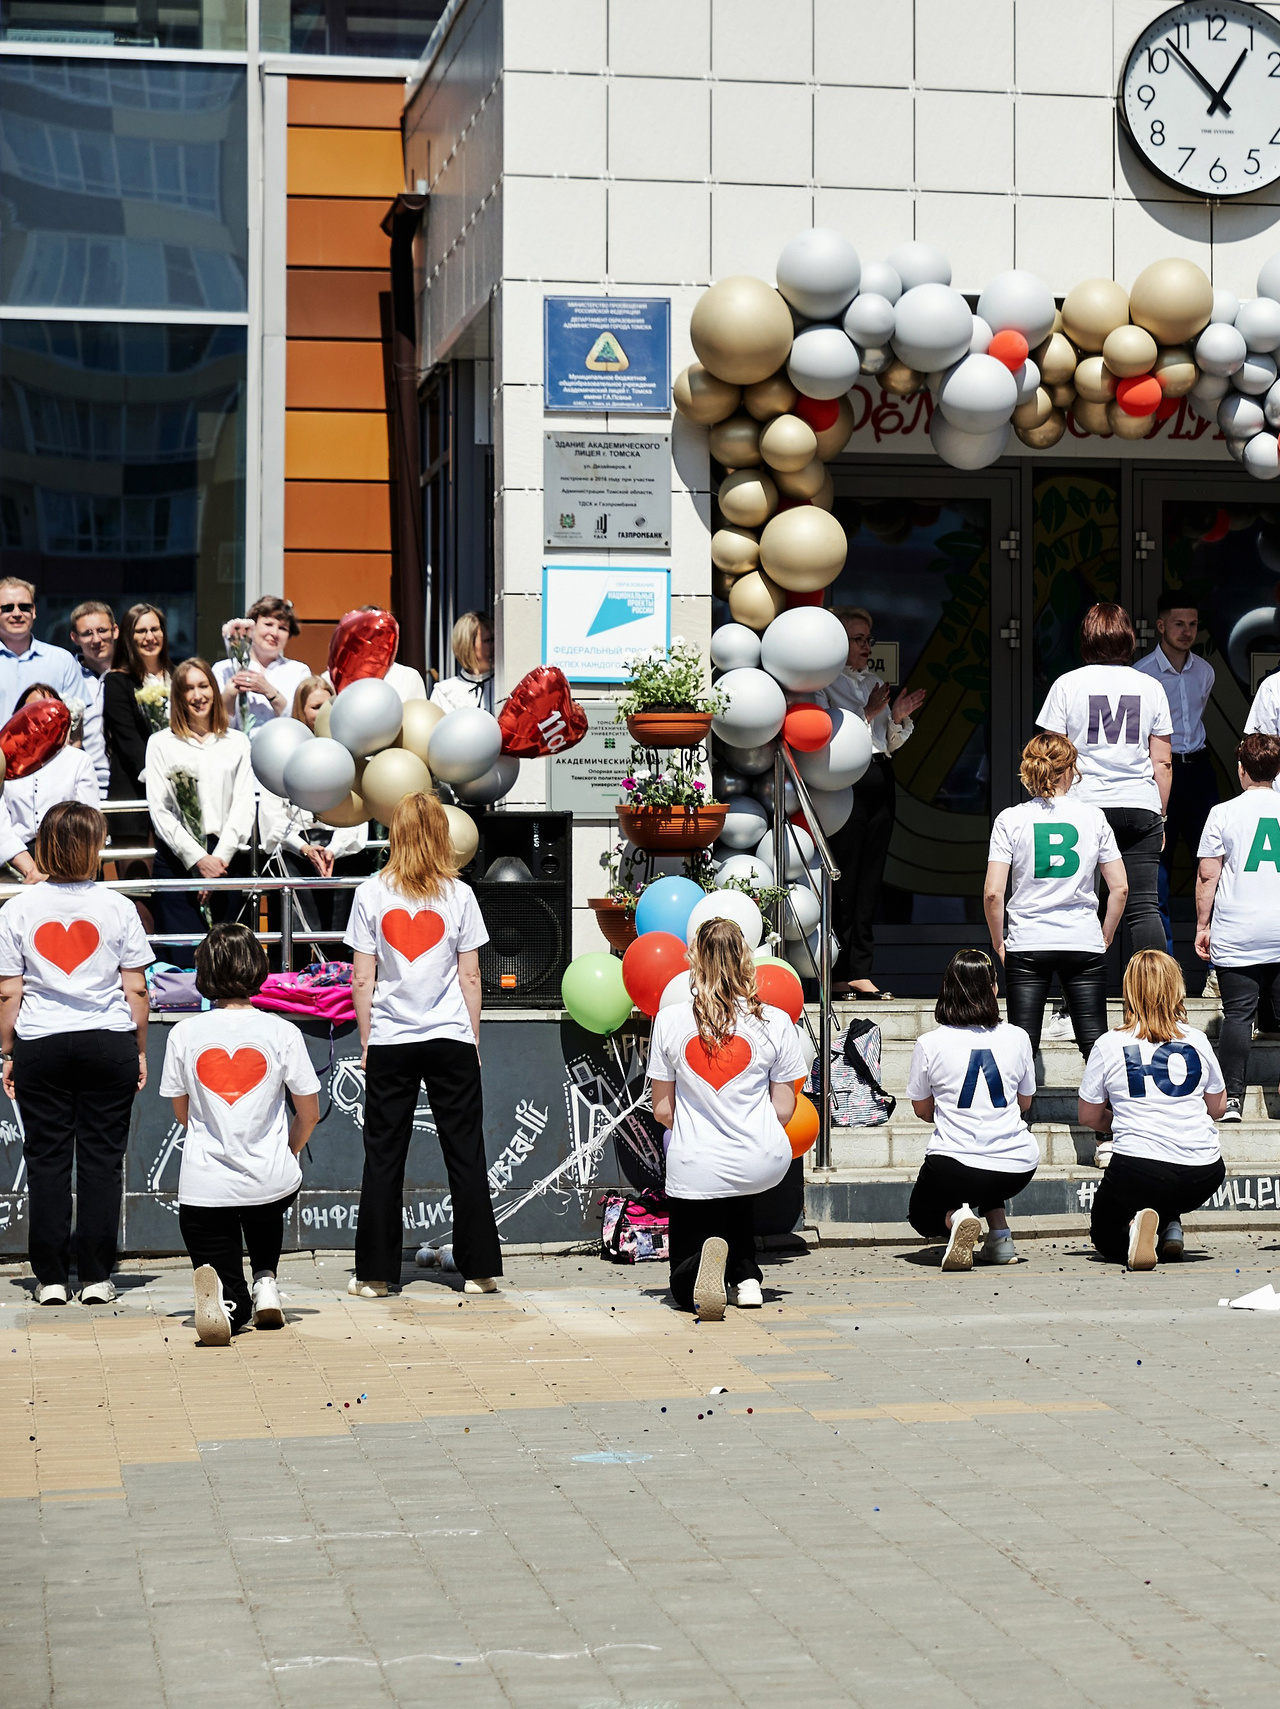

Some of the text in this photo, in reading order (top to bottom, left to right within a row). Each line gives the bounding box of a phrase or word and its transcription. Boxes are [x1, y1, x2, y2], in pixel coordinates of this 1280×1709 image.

[1174, 23, 1190, 49] 11
[1205, 15, 1227, 41] 12
[1247, 25, 1254, 52] 1
[1145, 46, 1170, 74] 10
[1137, 84, 1156, 111] 9
[1150, 119, 1165, 146] 8
[1178, 147, 1197, 173] 7
[1209, 157, 1227, 183] 6
[1244, 149, 1260, 175] 5
[555, 441, 661, 450] ЗДАНИЕ АКАДЕМИЧЕСКОГО
[618, 531, 663, 539] ГАЗПРОМБАНК
[607, 592, 654, 600] НАЦИОНАЛЬНЫЕ
[627, 599, 654, 607] ПРОЕКТЫ
[631, 606, 654, 614] РОССИИ
[553, 646, 623, 655] ФЕДЕРАЛЬНЫЙ
[581, 661, 621, 669] КАЖДОГО
[1086, 695, 1141, 744] М
[556, 757, 631, 765] АКАДЕМИЧЕСКИЙ
[1034, 823, 1079, 879] В
[957, 1049, 1008, 1109] Л
[1122, 1041, 1202, 1098] Ю
